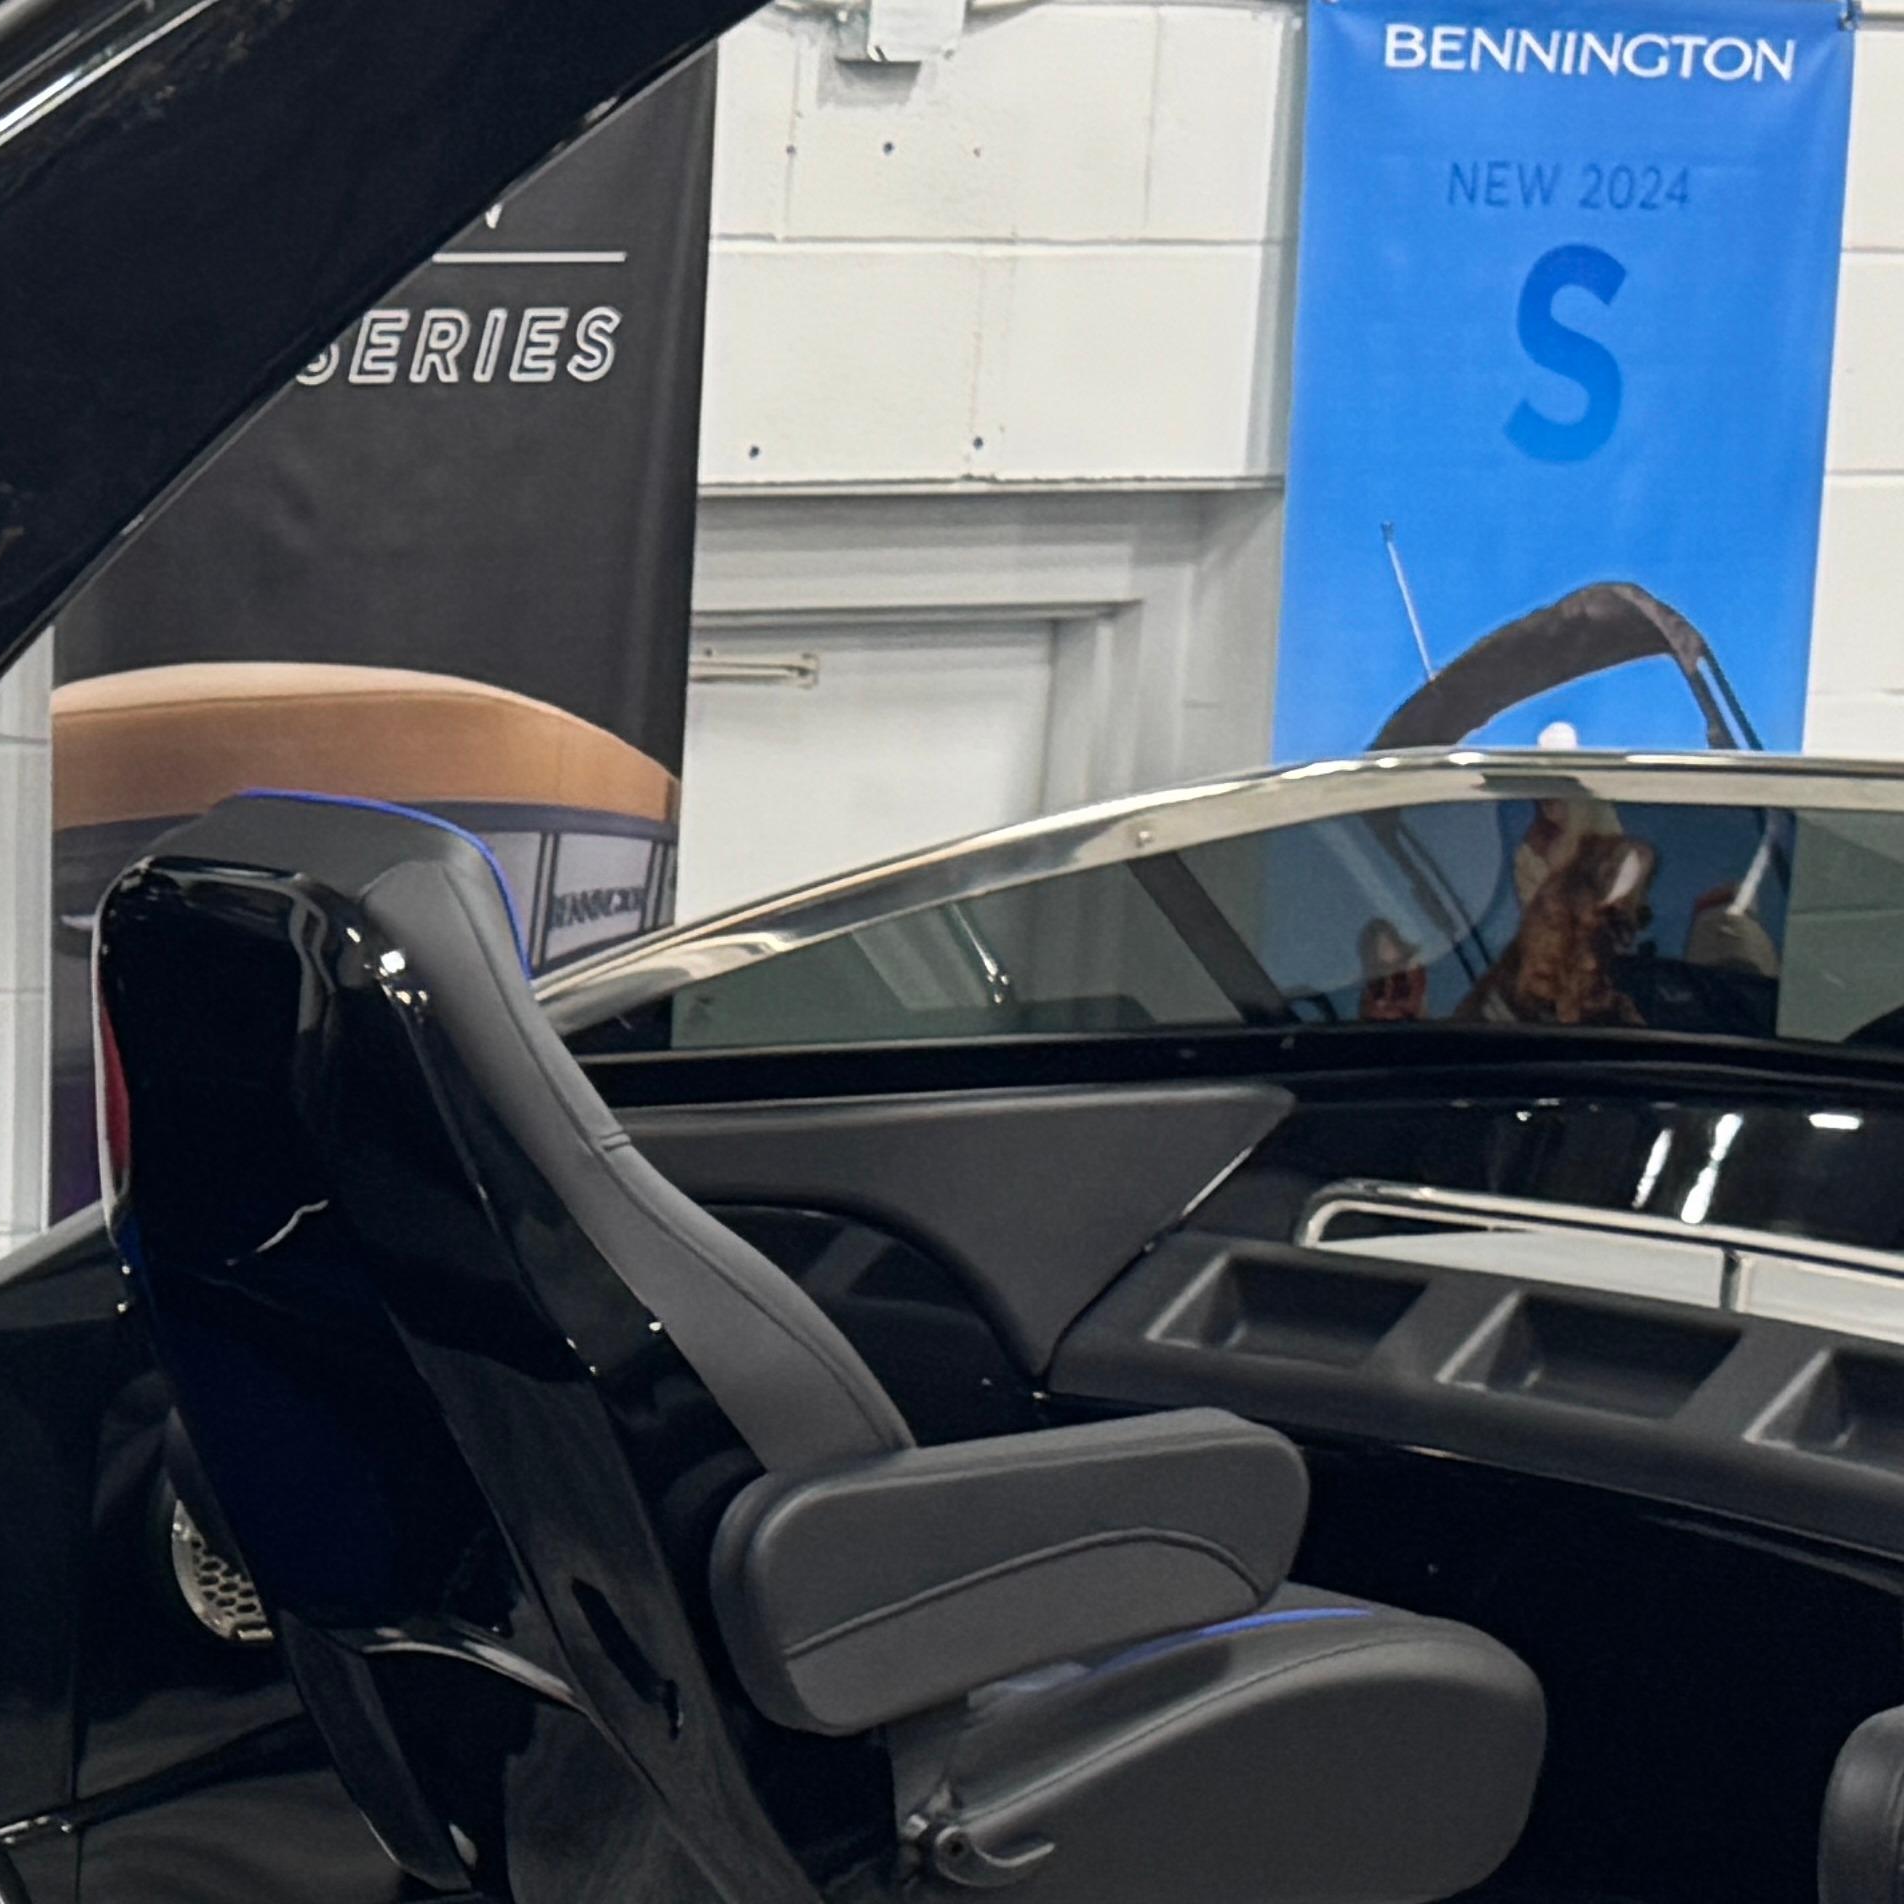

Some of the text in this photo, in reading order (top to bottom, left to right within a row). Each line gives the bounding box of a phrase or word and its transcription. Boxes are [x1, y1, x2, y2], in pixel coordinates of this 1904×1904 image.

[1385, 24, 1795, 81] BENNINGTON
[1447, 160, 1691, 211] NEW 2024
[1503, 243, 1628, 464] S
